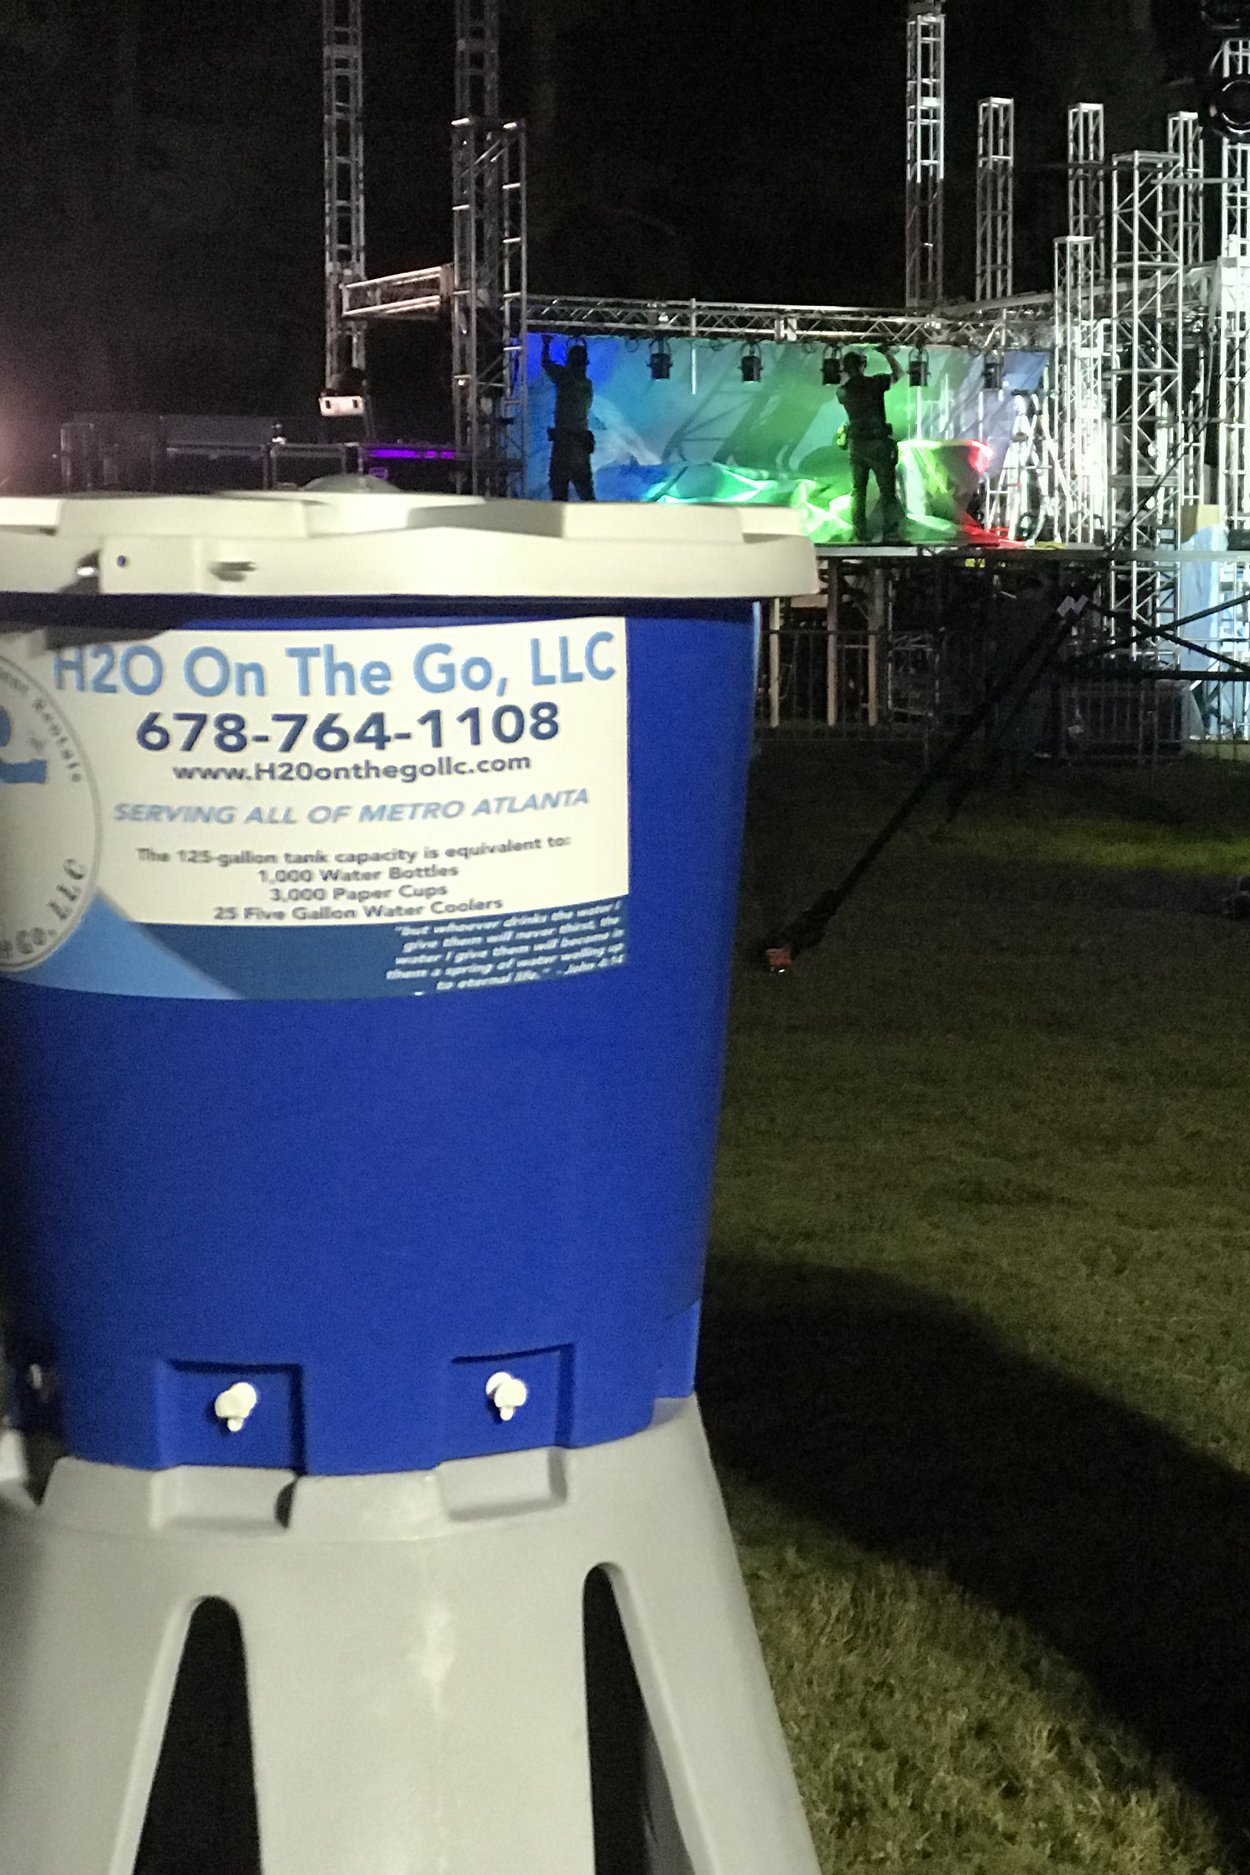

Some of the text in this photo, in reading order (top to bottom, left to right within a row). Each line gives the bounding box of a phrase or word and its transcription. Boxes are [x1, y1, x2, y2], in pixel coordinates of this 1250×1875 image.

[54, 645, 163, 696] H2O
[183, 646, 265, 697] On
[285, 643, 392, 696] The
[413, 642, 508, 697] Go,
[530, 631, 616, 687] LLC
[136, 701, 559, 753] 678-764-1108
[113, 788, 589, 825] SERVING ALL OF METRO ATLANTA
[135, 847, 170, 862] The
[176, 849, 277, 867] 125-gallon
[284, 849, 328, 864] tank
[334, 847, 418, 865] capacity
[424, 846, 439, 860] is
[445, 838, 542, 860] equivalent
[258, 864, 459, 884] 1,000 Water Bottles
[270, 883, 448, 904] 3,000 Paper Cups
[213, 897, 503, 920] 25 Five Gallon Water Coolers
